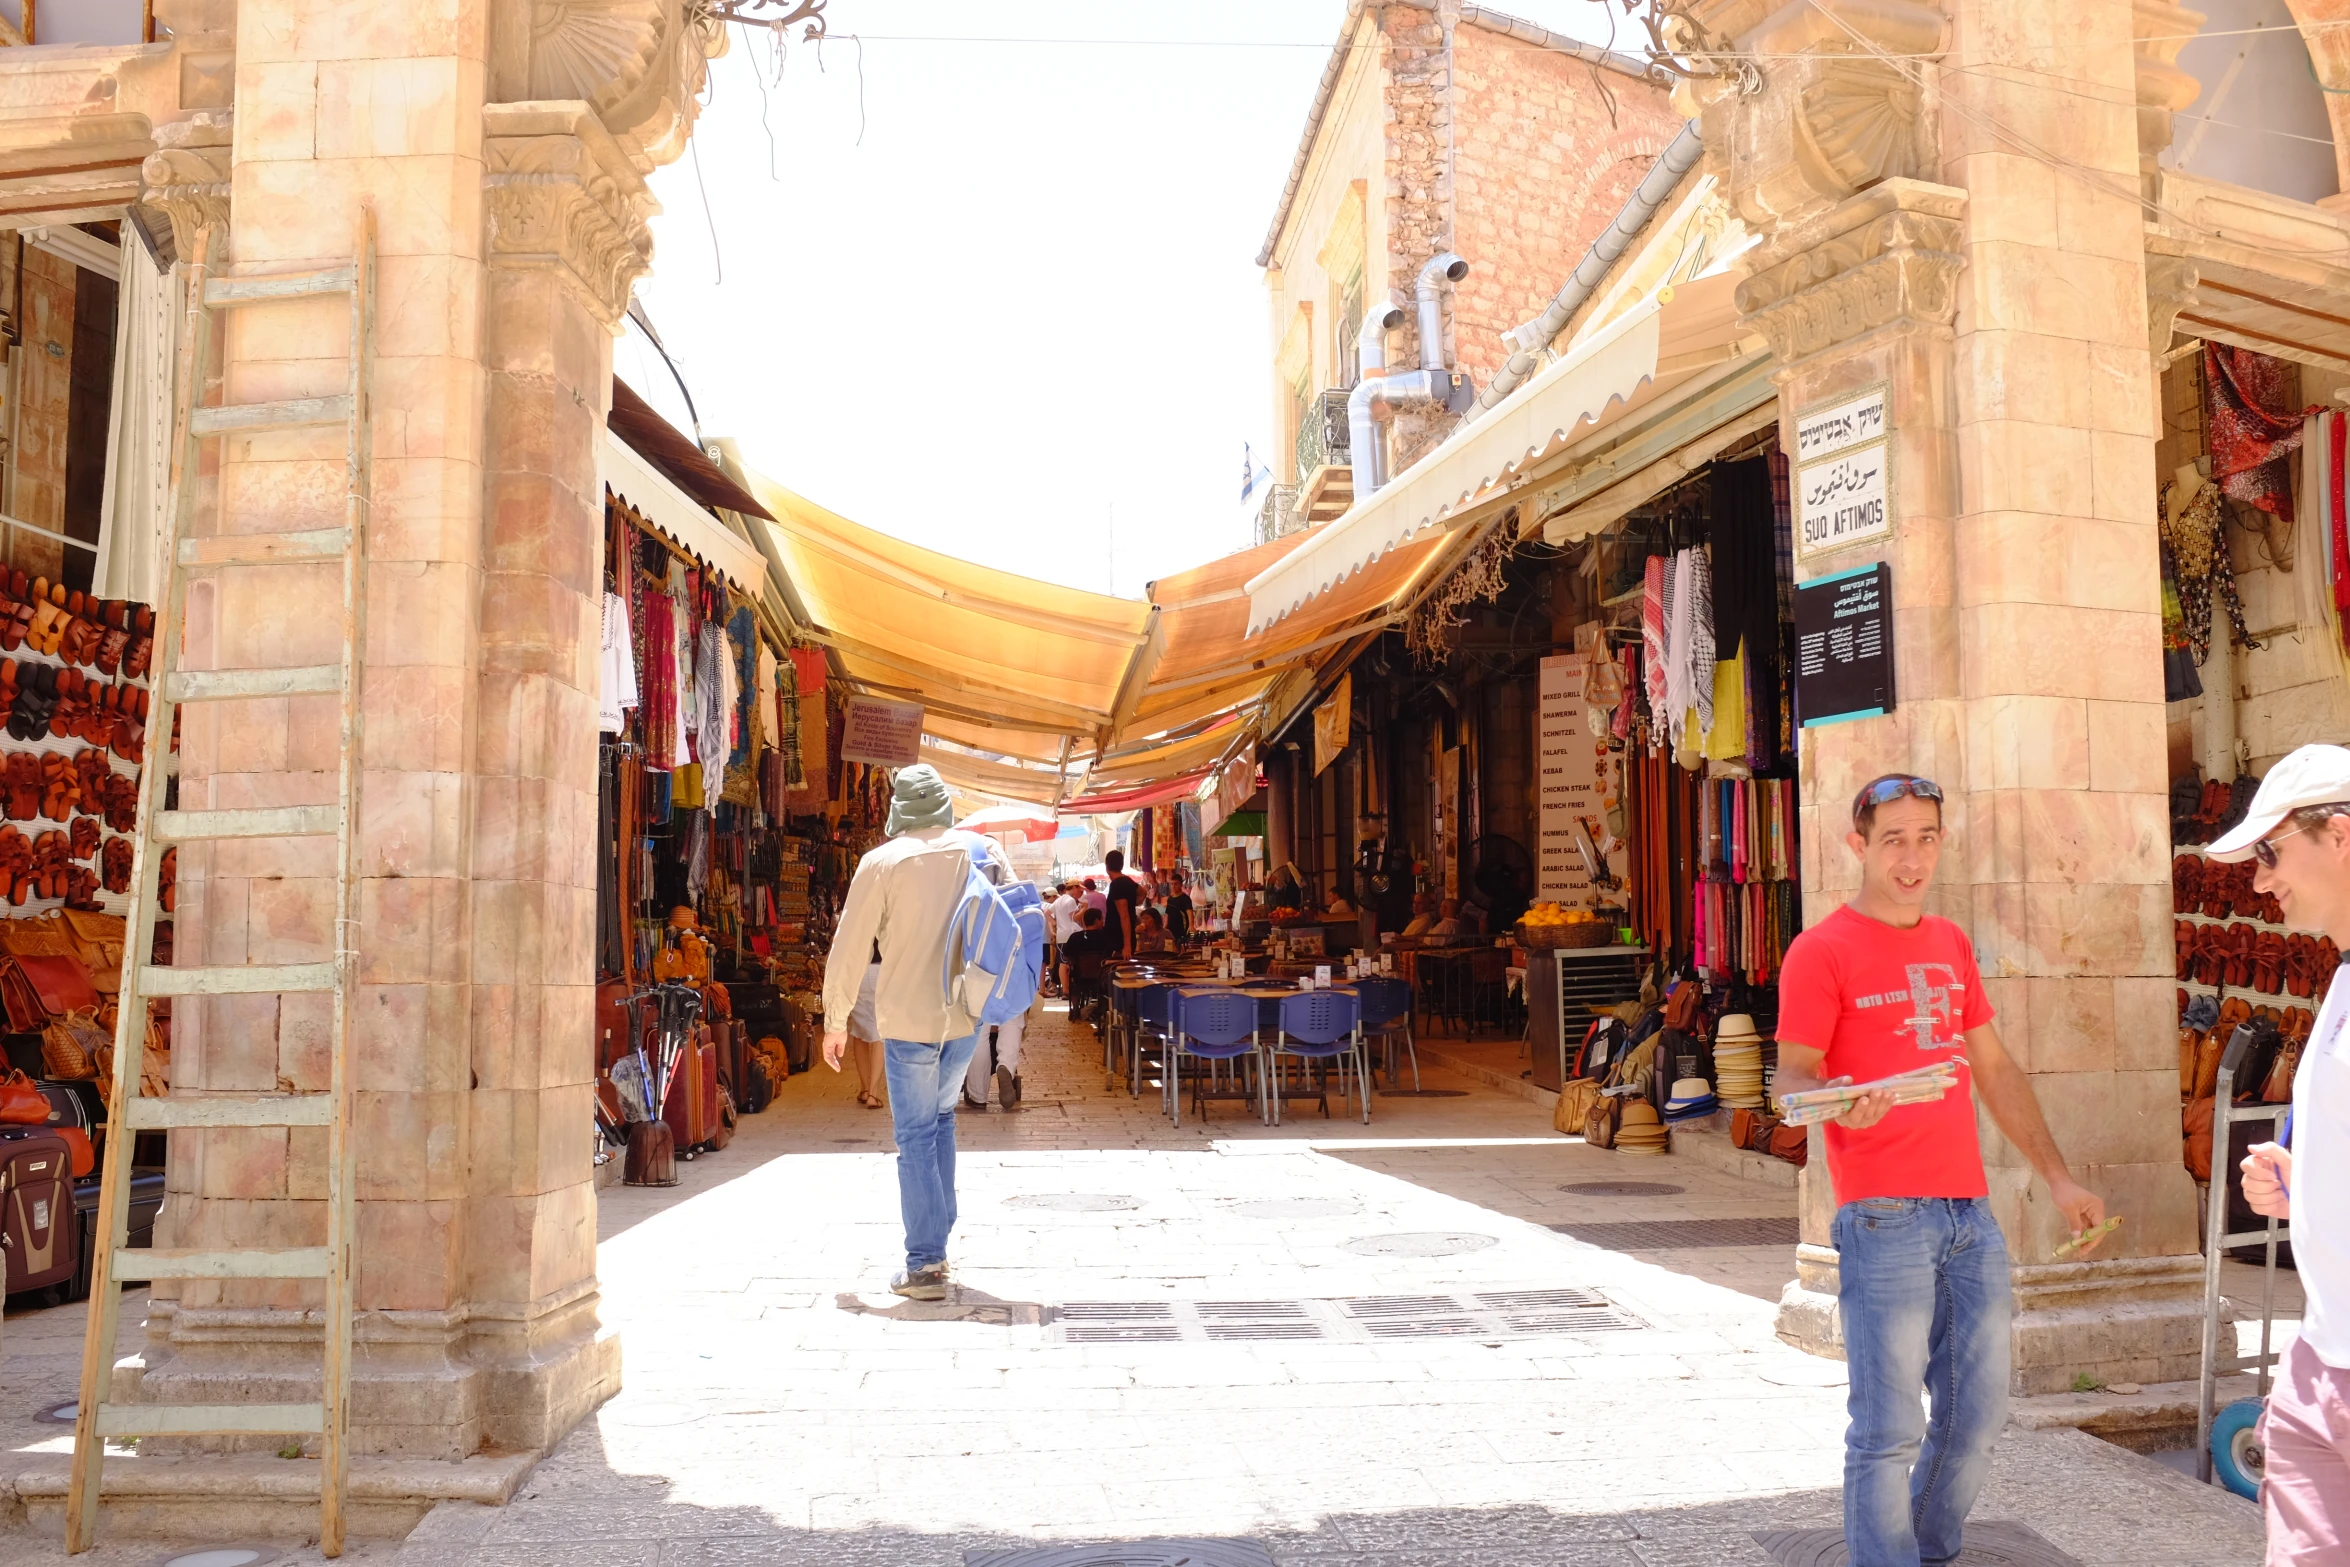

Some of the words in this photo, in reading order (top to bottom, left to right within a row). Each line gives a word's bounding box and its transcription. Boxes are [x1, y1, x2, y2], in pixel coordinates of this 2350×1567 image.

[1843, 468, 1878, 492] سوق
[1805, 515, 1827, 543] SUQ
[1834, 498, 1883, 536] AFTIMOS
[1866, 577, 1878, 587] שוק
[1863, 590, 1879, 602] سوق
[1834, 608, 1857, 619] Aftimos
[1858, 601, 1879, 613] Market
[1543, 692, 1561, 700] MIXED
[1563, 691, 1580, 699] GRILL
[852, 703, 891, 716] Jerusalem
[894, 708, 919, 718] Bazaar
[1543, 710, 1577, 719] SHAWERMA
[852, 712, 893, 724] Иерусалим
[895, 717, 917, 729] базар
[1543, 729, 1576, 738] SCHNITZEL
[874, 742, 891, 750] Silver
[1543, 767, 1563, 775] KEBAB
[1543, 785, 1569, 793] CHICKEN
[1571, 784, 1591, 792] STEAK
[1543, 802, 1566, 810] FRENCH
[1567, 801, 1585, 809] FRIES
[1543, 829, 1569, 837] HUMMUS
[1543, 847, 1562, 855] GREEK
